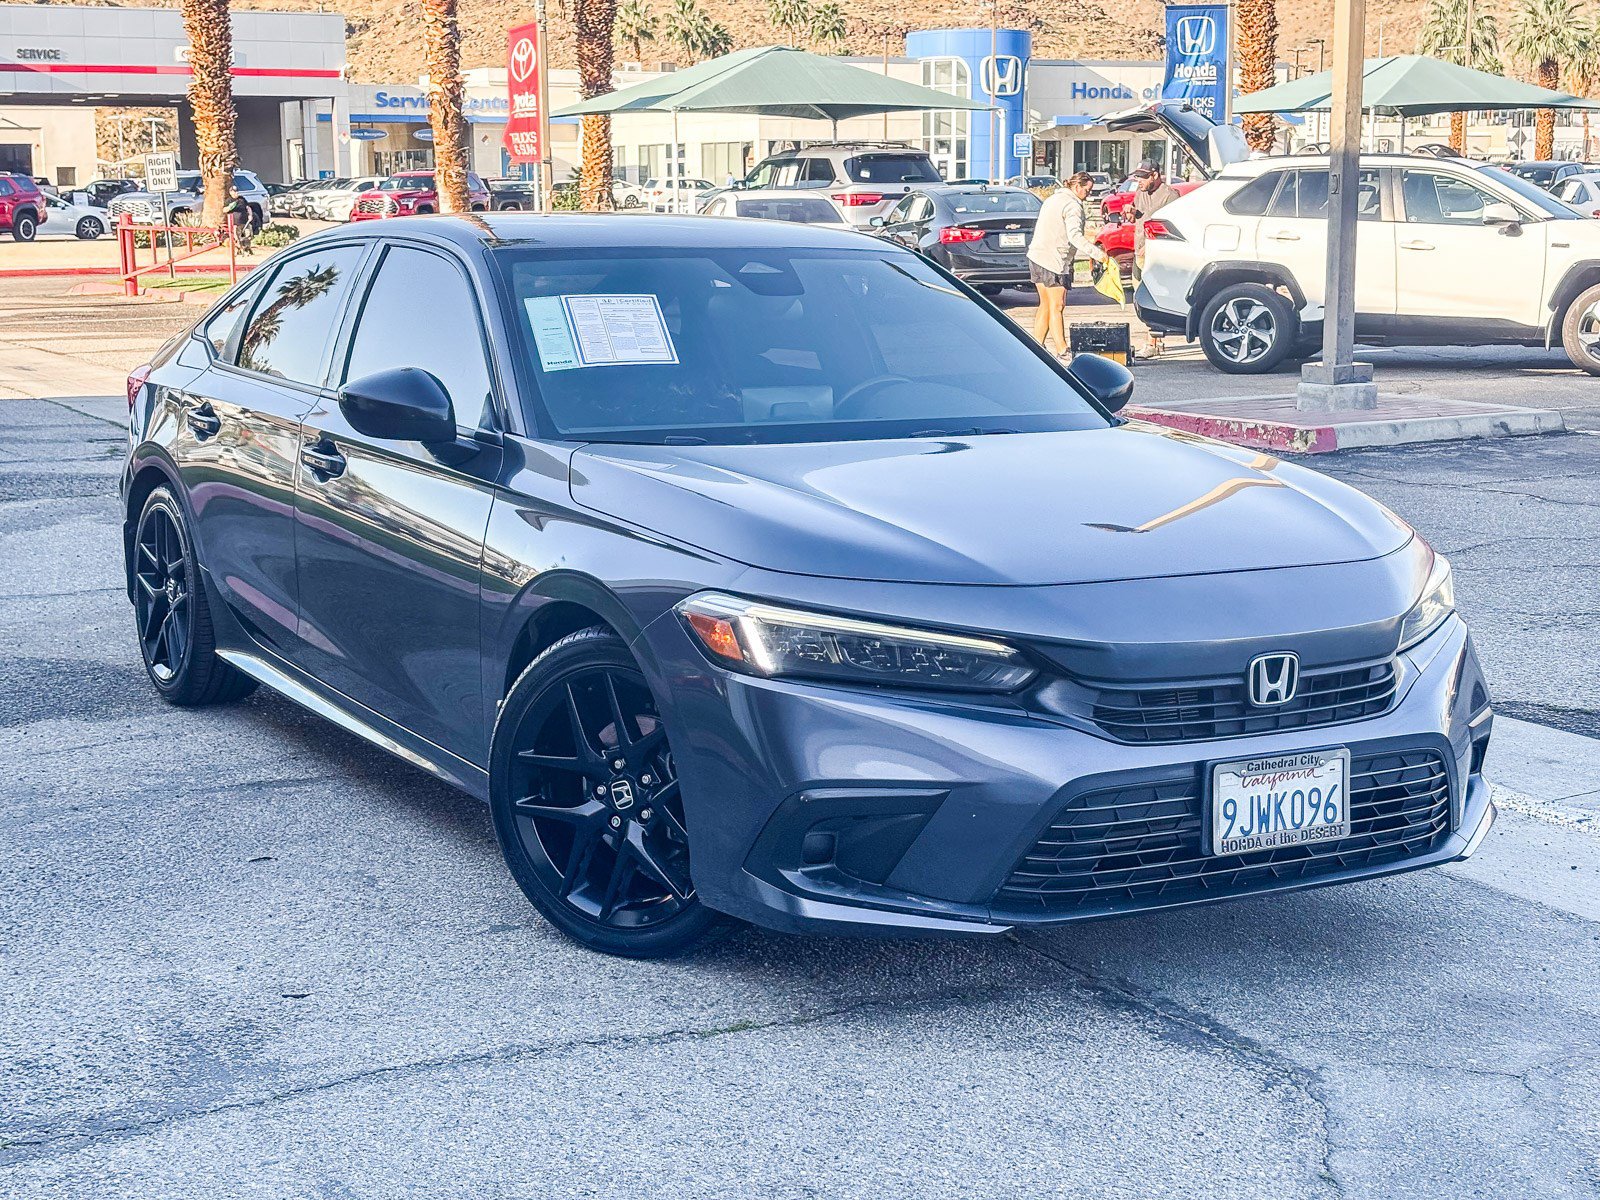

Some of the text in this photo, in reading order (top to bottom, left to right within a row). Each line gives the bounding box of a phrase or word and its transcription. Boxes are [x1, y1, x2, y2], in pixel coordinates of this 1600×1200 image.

[16, 48, 61, 60] SERVICE
[1174, 62, 1217, 78] Honda
[1070, 82, 1162, 99] Honda of
[375, 91, 509, 110] Servi ente
[148, 158, 171, 166] RIGHT
[150, 168, 171, 176] TURN
[152, 177, 172, 186] ONLY
[1246, 755, 1321, 773] Cathedral City
[1241, 767, 1324, 791] California
[1221, 783, 1339, 840] 9JWK096
[1221, 824, 1345, 854] HONDA of the DESERT
